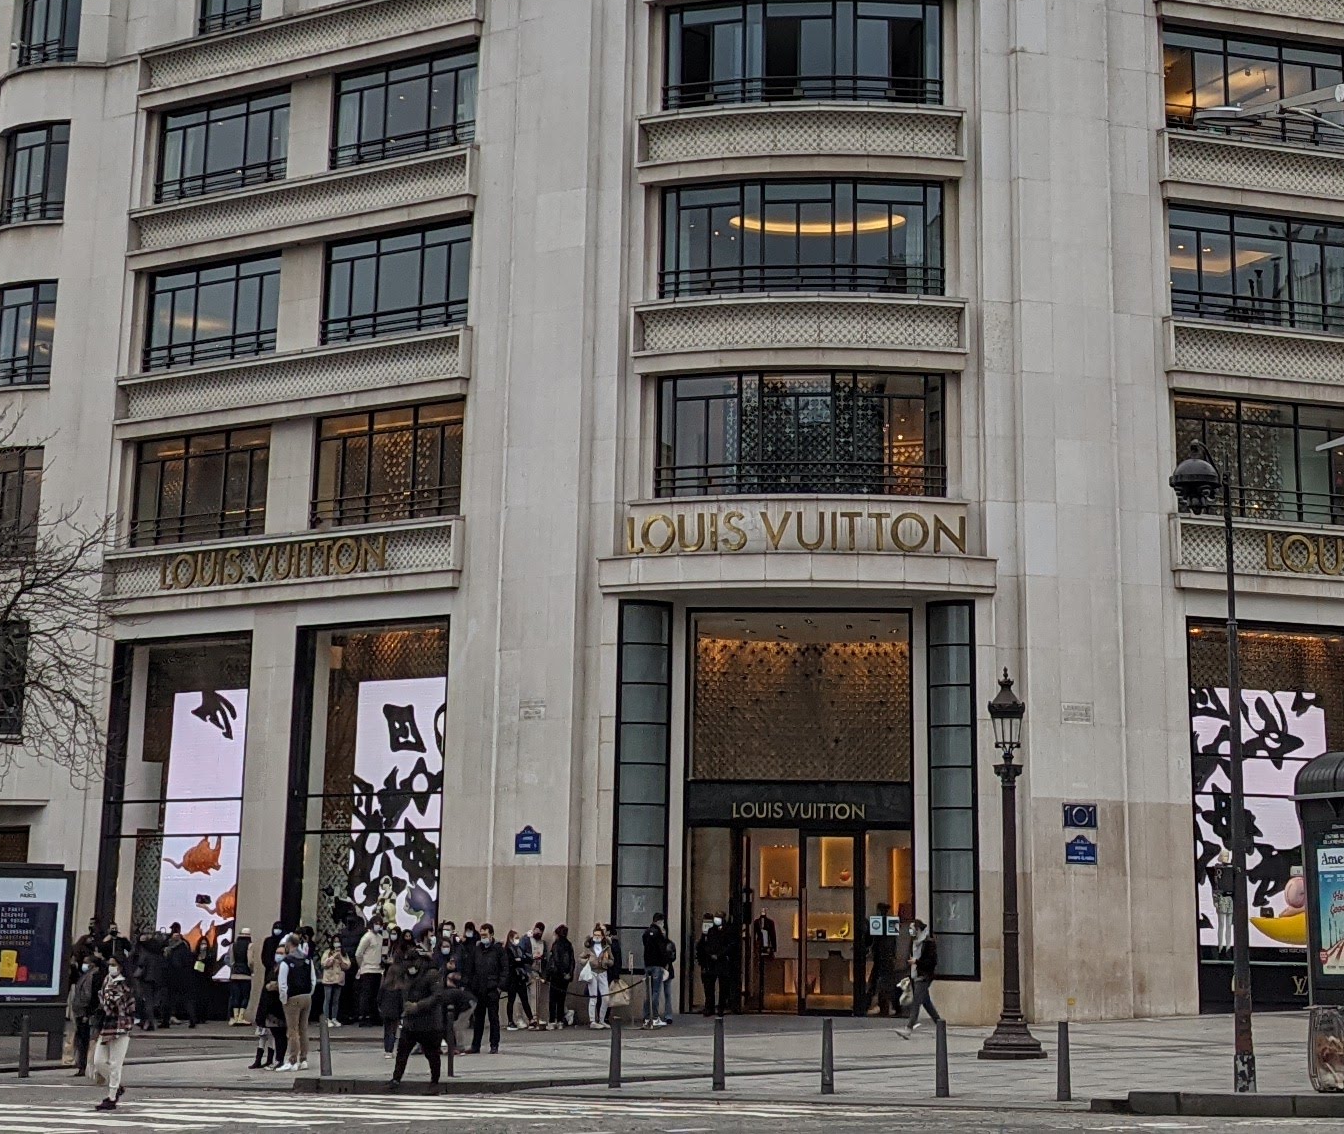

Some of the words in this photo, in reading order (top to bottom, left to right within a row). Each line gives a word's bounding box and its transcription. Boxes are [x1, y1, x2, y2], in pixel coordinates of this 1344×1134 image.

[625, 511, 748, 555] LOUIS
[759, 511, 967, 555] VUITTON
[158, 548, 245, 591] LOUIS
[250, 535, 387, 582] VUITTON
[732, 801, 784, 819] LOUIS
[786, 802, 866, 820] VUITTON
[1064, 805, 1096, 826] 101
